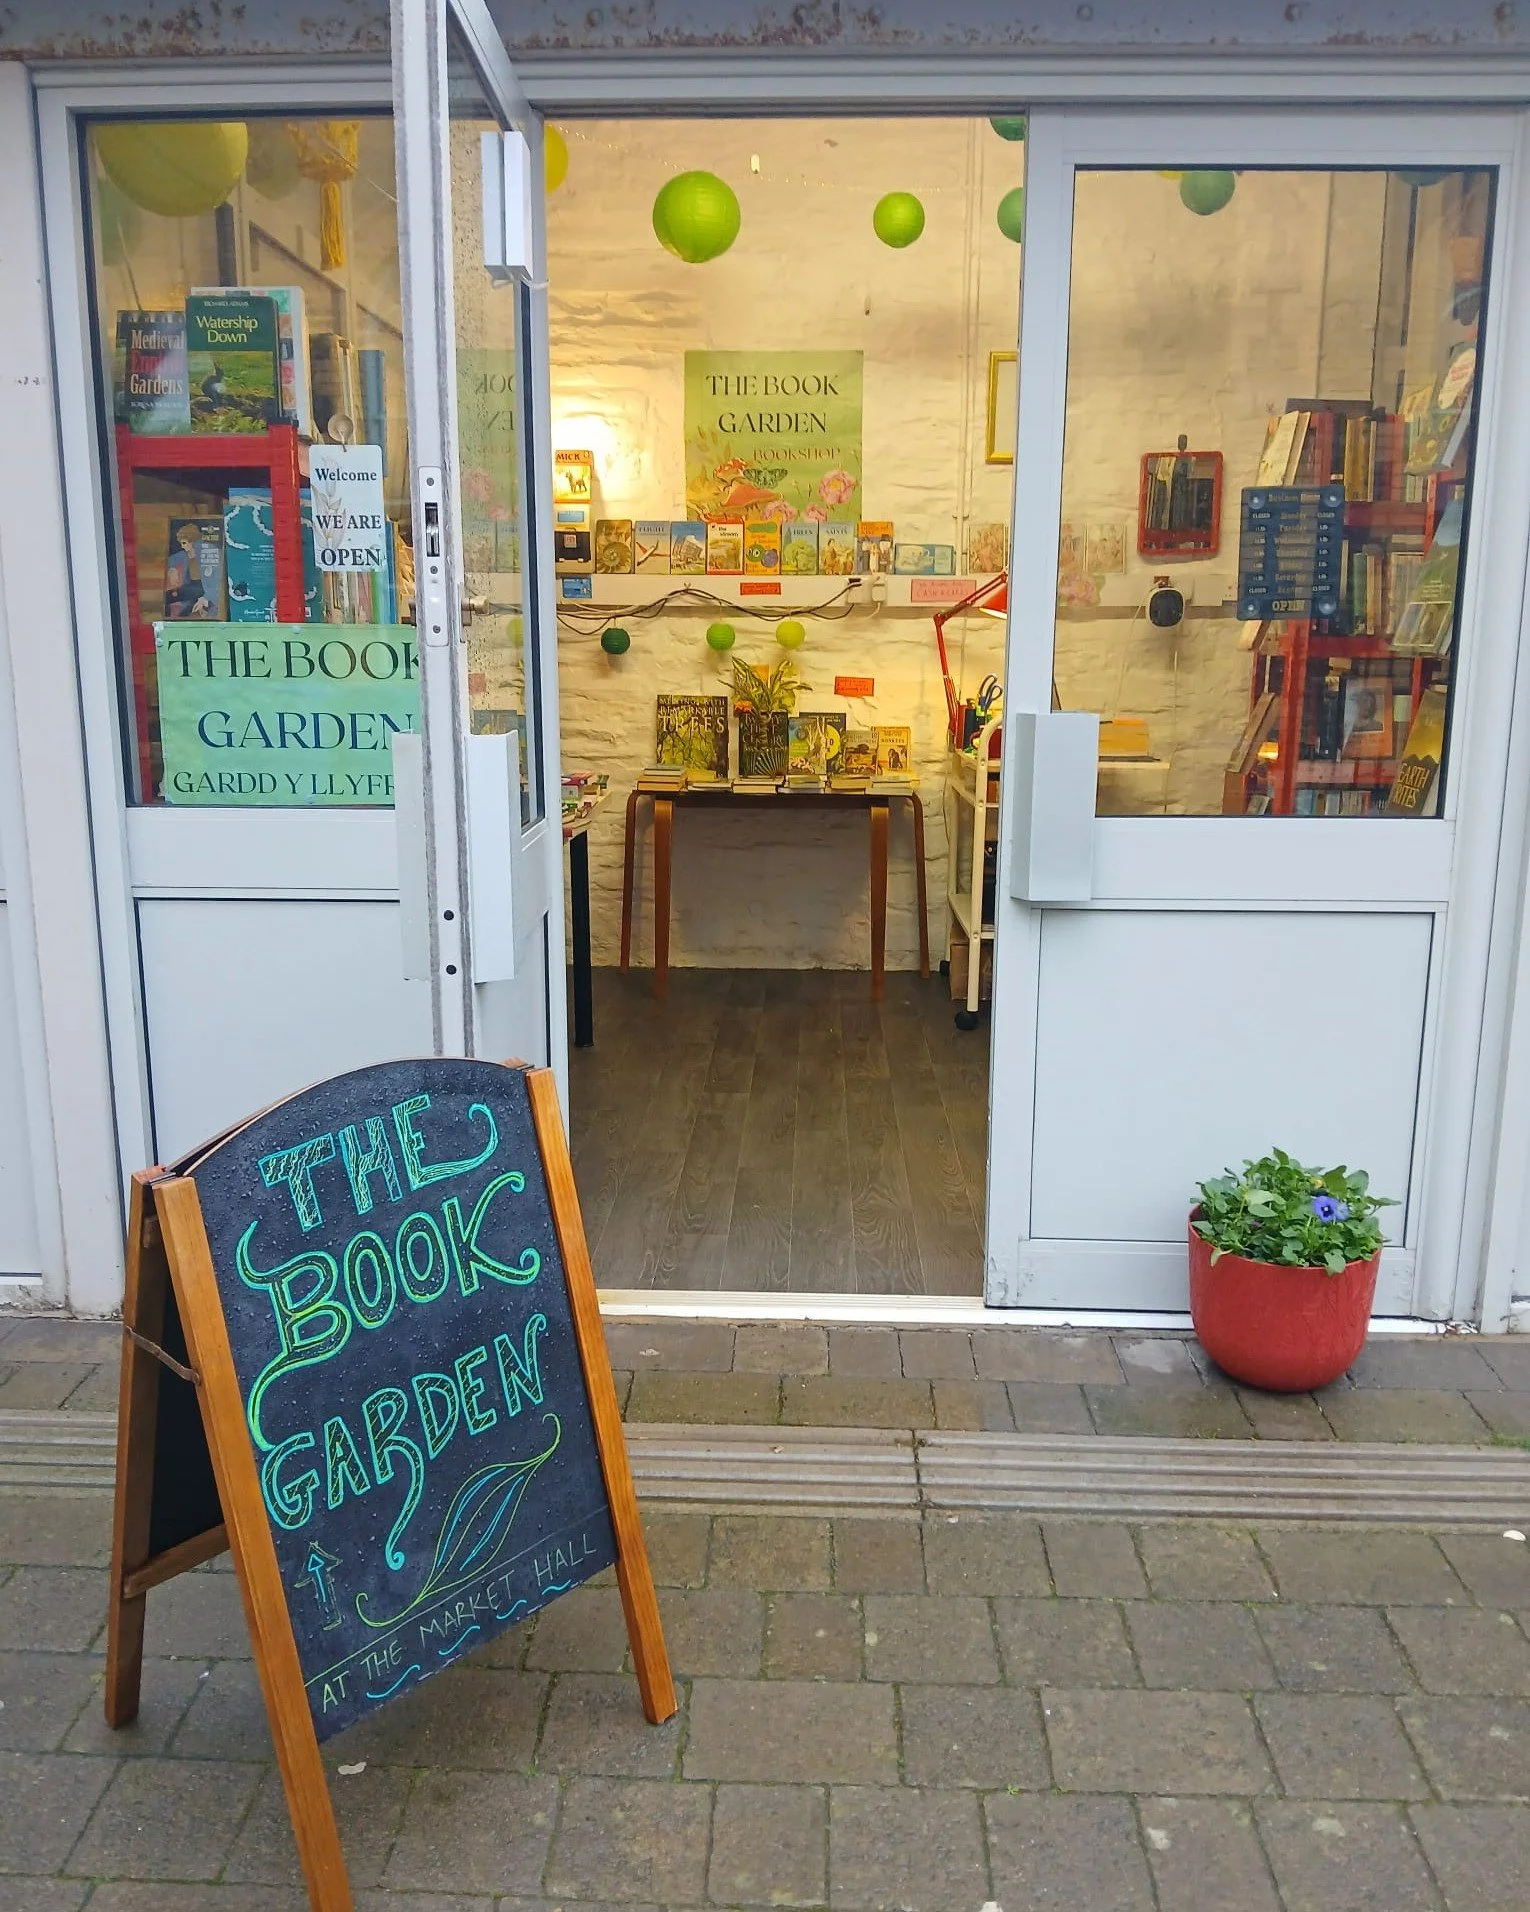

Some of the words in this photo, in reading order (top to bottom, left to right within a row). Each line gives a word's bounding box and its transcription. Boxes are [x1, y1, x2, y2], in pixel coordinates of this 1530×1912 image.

[196, 315, 258, 332] Watership
[131, 330, 185, 350] Medieval
[207, 330, 248, 343] Down
[130, 374, 183, 395] Gardens
[705, 374, 757, 396] THE
[764, 374, 839, 396] BOOK
[718, 412, 827, 434] GARDEN
[556, 453, 580, 461] MICK
[753, 447, 841, 461] BOOKSHOP
[314, 468, 377, 481] Welcome
[315, 515, 344, 530] WE
[347, 515, 382, 530] ARE
[320, 548, 381, 567] OPEN
[168, 640, 273, 678] THE
[198, 711, 414, 751] GARDEN
[657, 715, 726, 734] TREES
[173, 771, 277, 794] GARDD
[284, 773, 304, 795] Y
[1397, 762, 1430, 789] EARTH
[259, 1094, 498, 1232] THE
[237, 1171, 541, 1450] BOOK
[261, 1313, 547, 1569] GARDEN
[322, 1670, 350, 1714] AT
[360, 1640, 402, 1680] THE
[419, 1569, 515, 1648] MARKET
[534, 1533, 598, 1587] HALL
